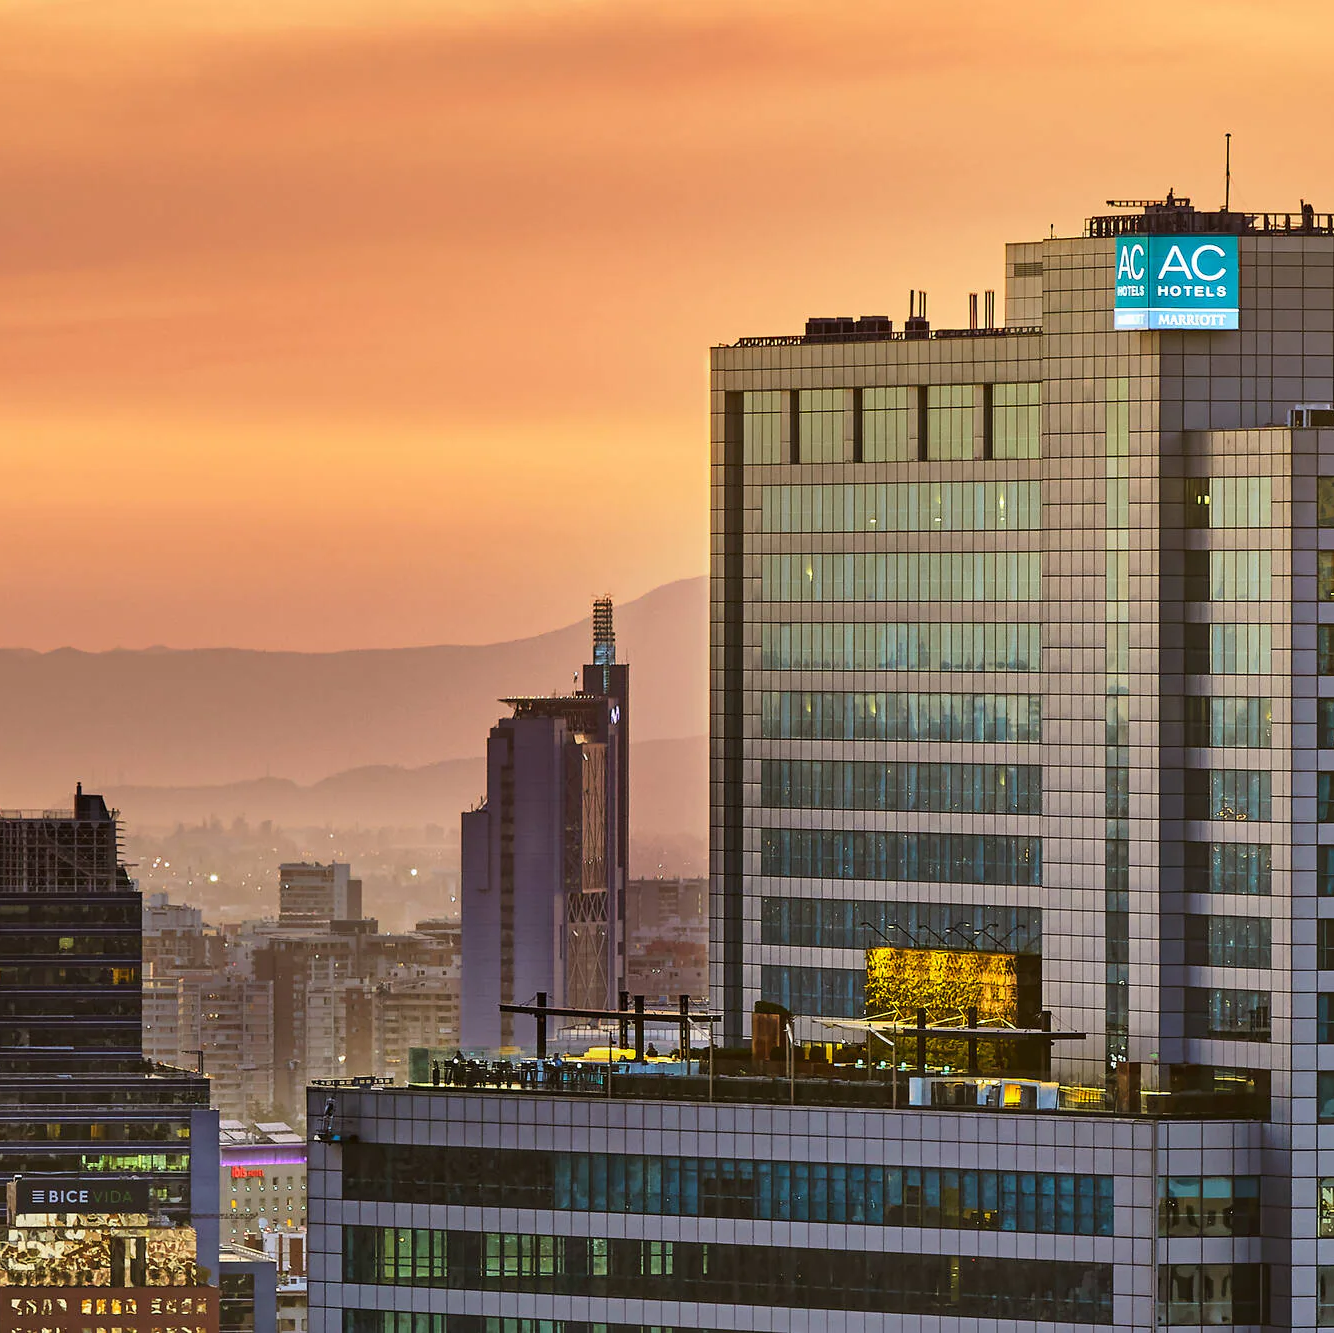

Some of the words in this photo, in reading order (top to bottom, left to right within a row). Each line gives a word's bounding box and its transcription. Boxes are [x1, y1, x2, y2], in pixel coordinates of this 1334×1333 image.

[1117, 244, 1145, 281] AC
[1157, 244, 1227, 281] AC
[1117, 285, 1145, 297] HOTELS
[1157, 285, 1227, 298] HOTELS
[1158, 314, 1227, 326] MARRIOTT
[48, 1190, 89, 1203] BICE
[93, 1190, 133, 1203] VIDA
